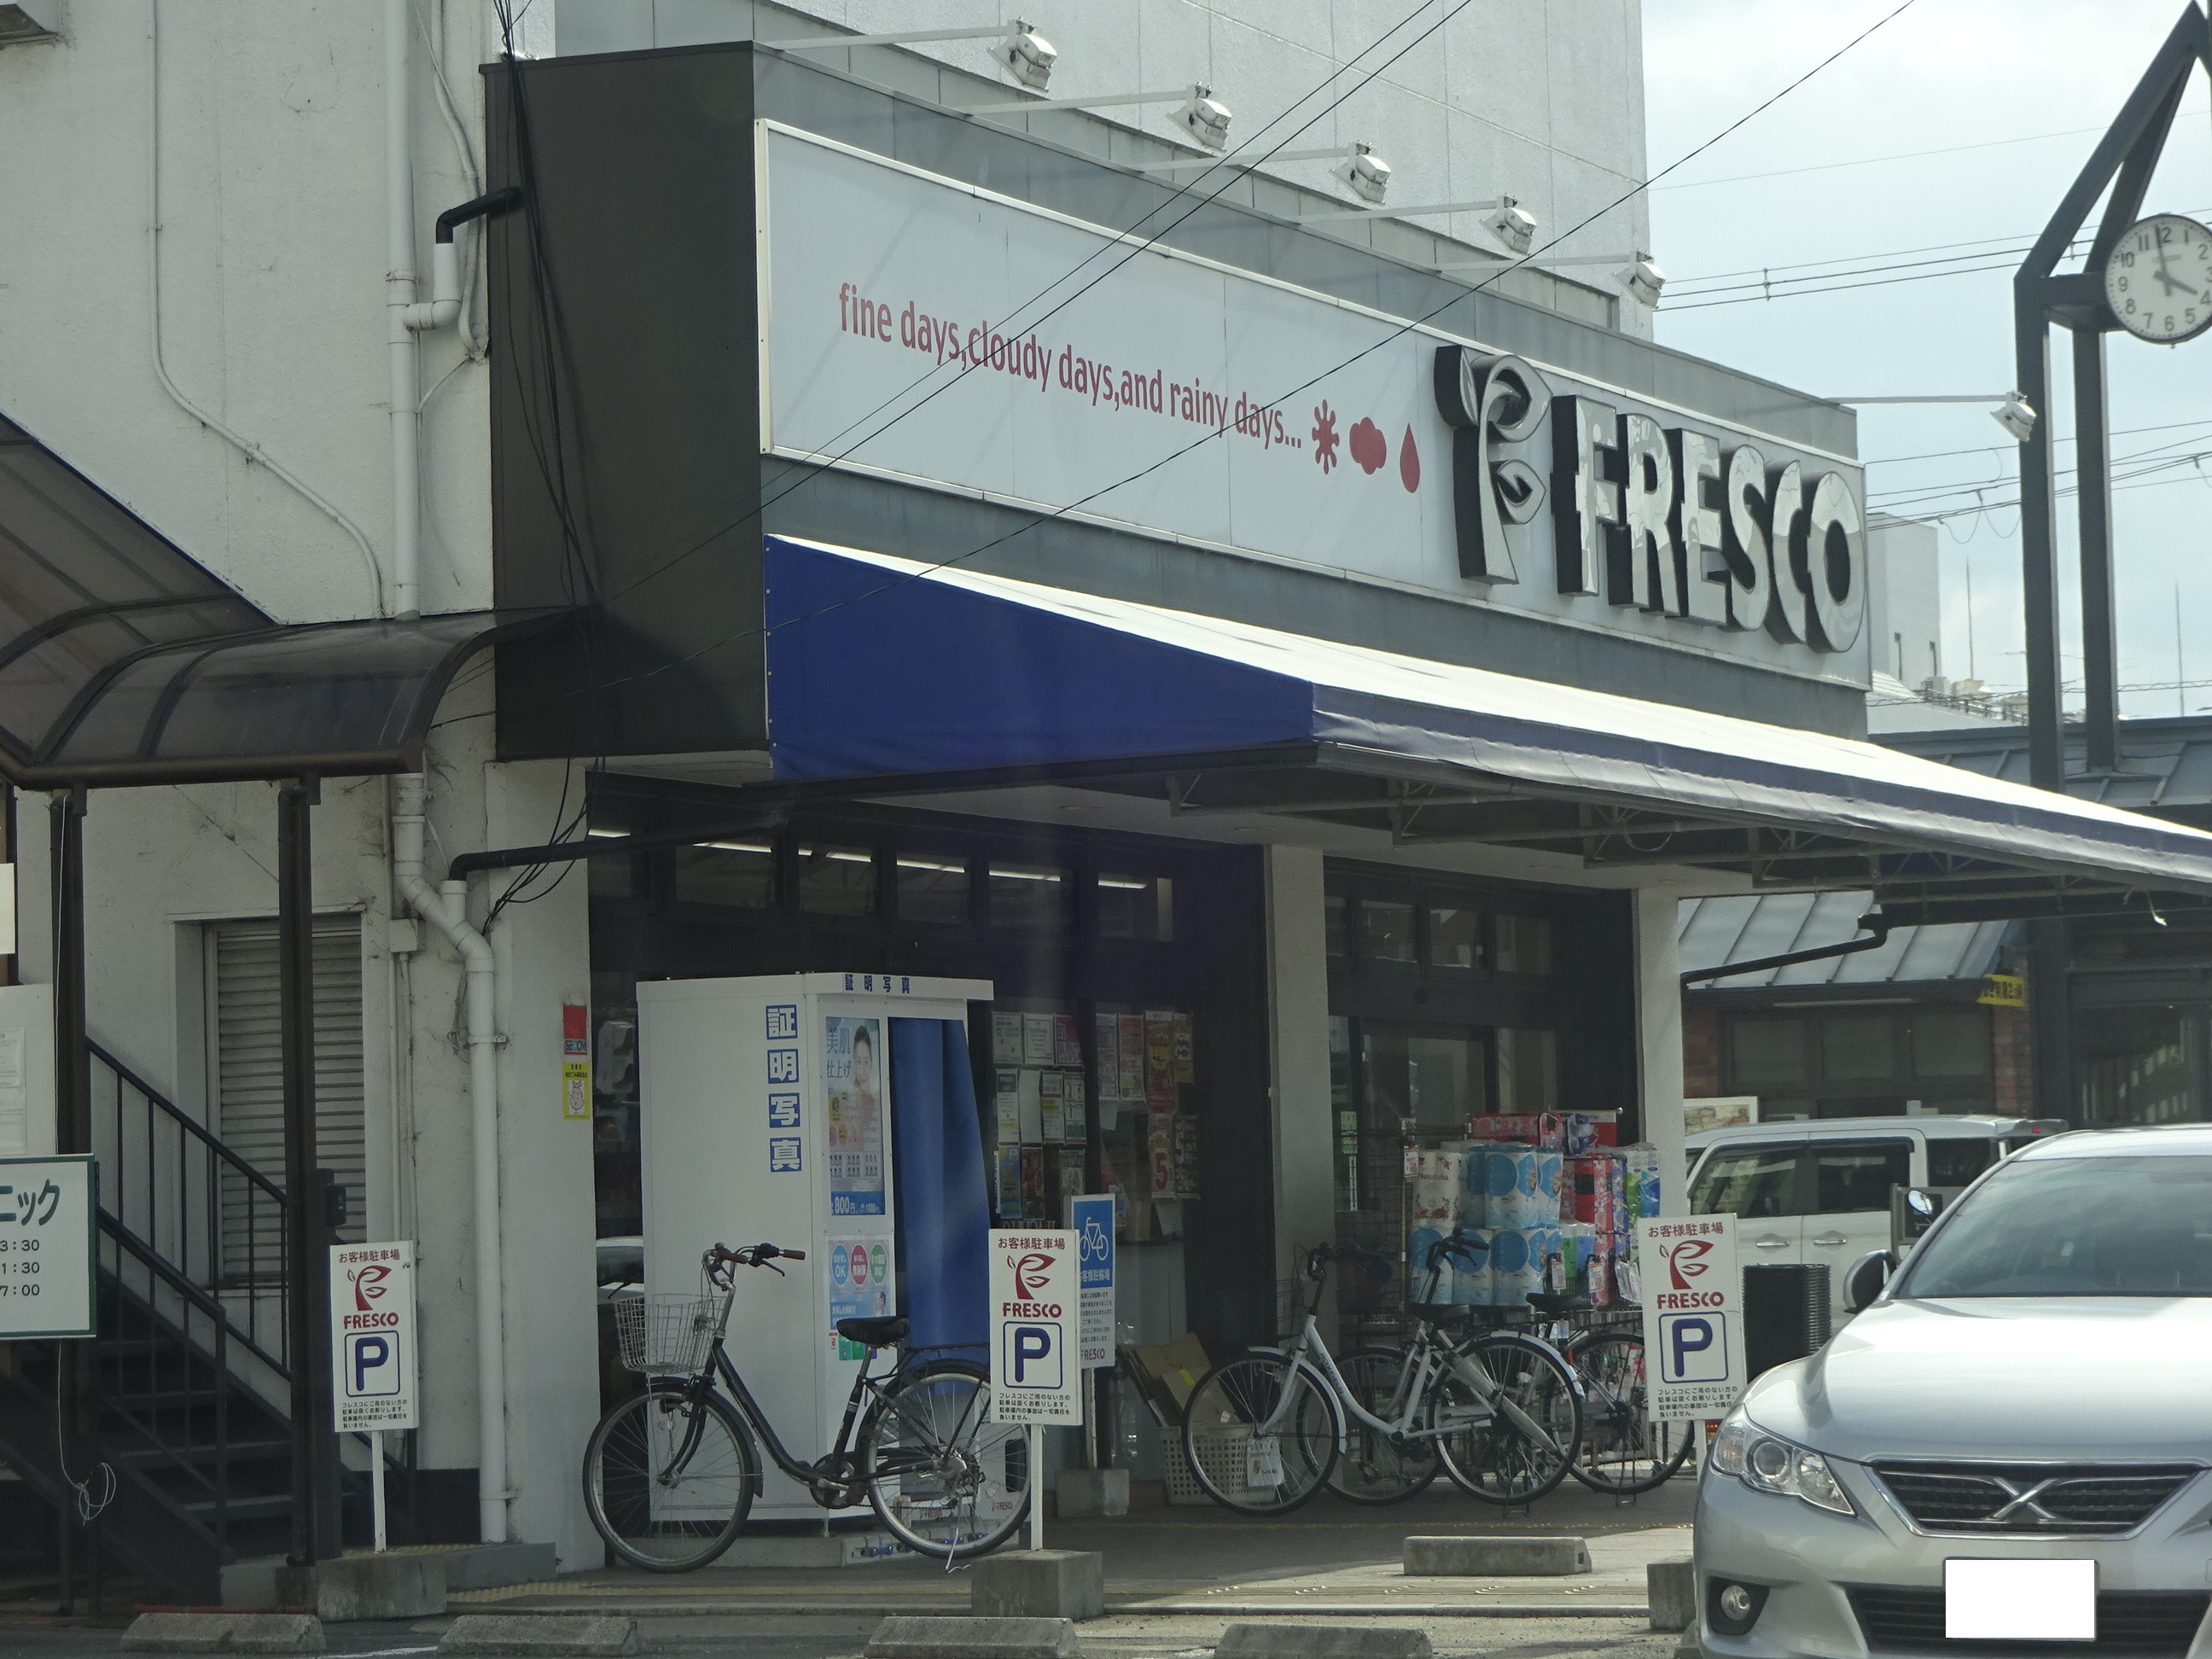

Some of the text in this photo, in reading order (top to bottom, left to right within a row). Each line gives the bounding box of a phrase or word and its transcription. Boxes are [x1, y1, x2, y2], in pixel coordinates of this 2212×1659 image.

[2138, 233, 2150, 252] 11
[2184, 230, 2189, 246] 1
[2120, 251, 2134, 268] 10
[2198, 243, 2209, 260] 2
[2118, 276, 2128, 292] 9
[2200, 290, 2212, 306] 4
[2125, 299, 2136, 315] 8
[2143, 312, 2153, 329] 7
[2164, 315, 2174, 332] 6
[2185, 308, 2196, 324] 5
[839, 282, 893, 343] fine
[1170, 378, 1228, 439] rainy
[1551, 394, 1864, 653] FRESCO
[845, 974, 911, 994] 証明写真
[826, 1027, 852, 1055] 美肌
[766, 1005, 801, 1173] 証明写真
[0, 1179, 61, 1225] ニック
[1648, 1221, 1724, 1238] お客様駐車場
[998, 1237, 1066, 1250] お客様駐車場
[339, 1249, 400, 1263] お客様駐車場
[835, 1265, 847, 1278] OK
[1080, 1268, 1110, 1282] 客様駐輪場
[1656, 1291, 1725, 1309] FRESCO
[1003, 1302, 1062, 1318] FRESCO
[343, 1312, 399, 1330] FRESCO
[1015, 1327, 1051, 1382] P
[1672, 1318, 1713, 1377] P
[355, 1336, 389, 1392] P
[1657, 1386, 1738, 1396] フレスコにご用のない方の
[1658, 1402, 1732, 1411] 駐車場内の事故は一切責任
